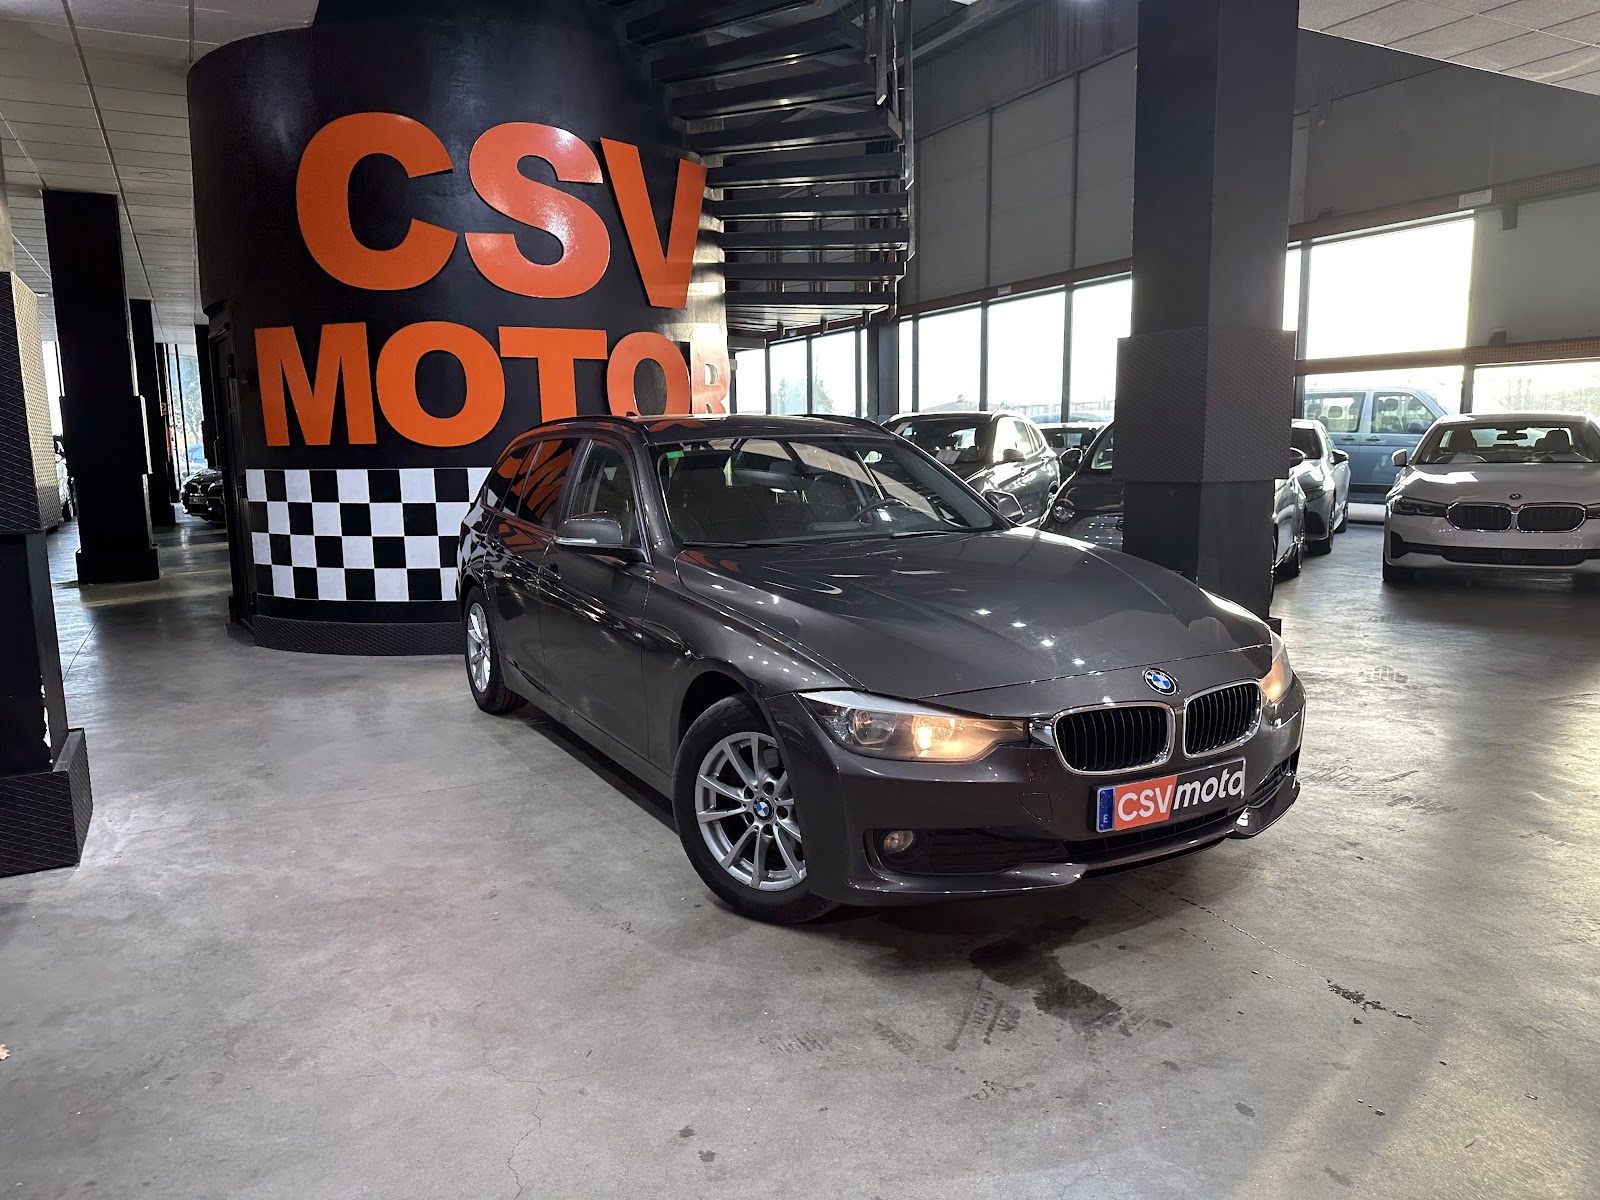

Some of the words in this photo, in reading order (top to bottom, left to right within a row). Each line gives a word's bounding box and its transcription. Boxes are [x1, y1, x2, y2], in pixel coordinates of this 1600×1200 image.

[296, 111, 707, 309] CSV
[254, 321, 730, 447] MOTOR
[1103, 813, 1109, 824] E
